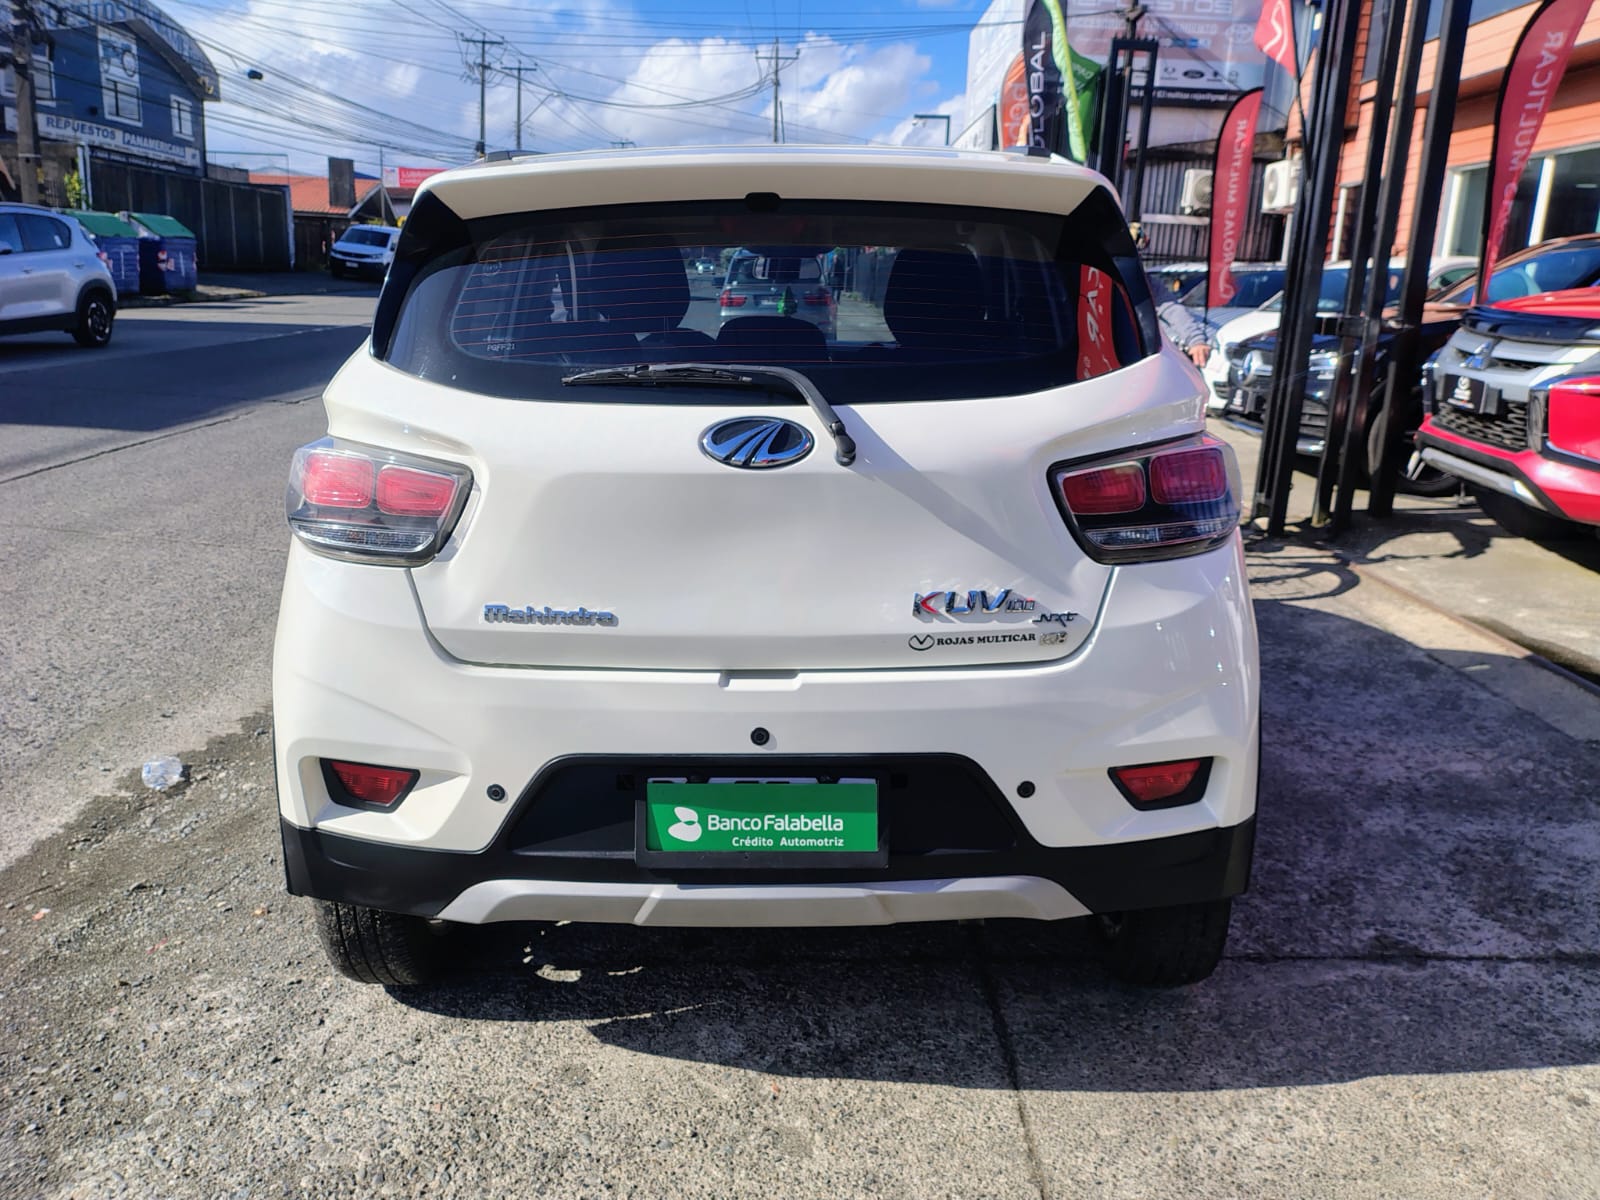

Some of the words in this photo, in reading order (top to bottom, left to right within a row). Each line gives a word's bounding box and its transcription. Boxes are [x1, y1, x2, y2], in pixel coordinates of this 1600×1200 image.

[46, 115, 116, 141] REPUESTOS
[484, 603, 618, 626] Mahindra
[936, 636, 974, 646] ROJAS
[976, 633, 1037, 645] MULTICAR
[707, 814, 761, 831] Banco
[763, 814, 844, 831] Falabella
[731, 836, 774, 847] Crédito
[779, 836, 844, 847] Automotriz
